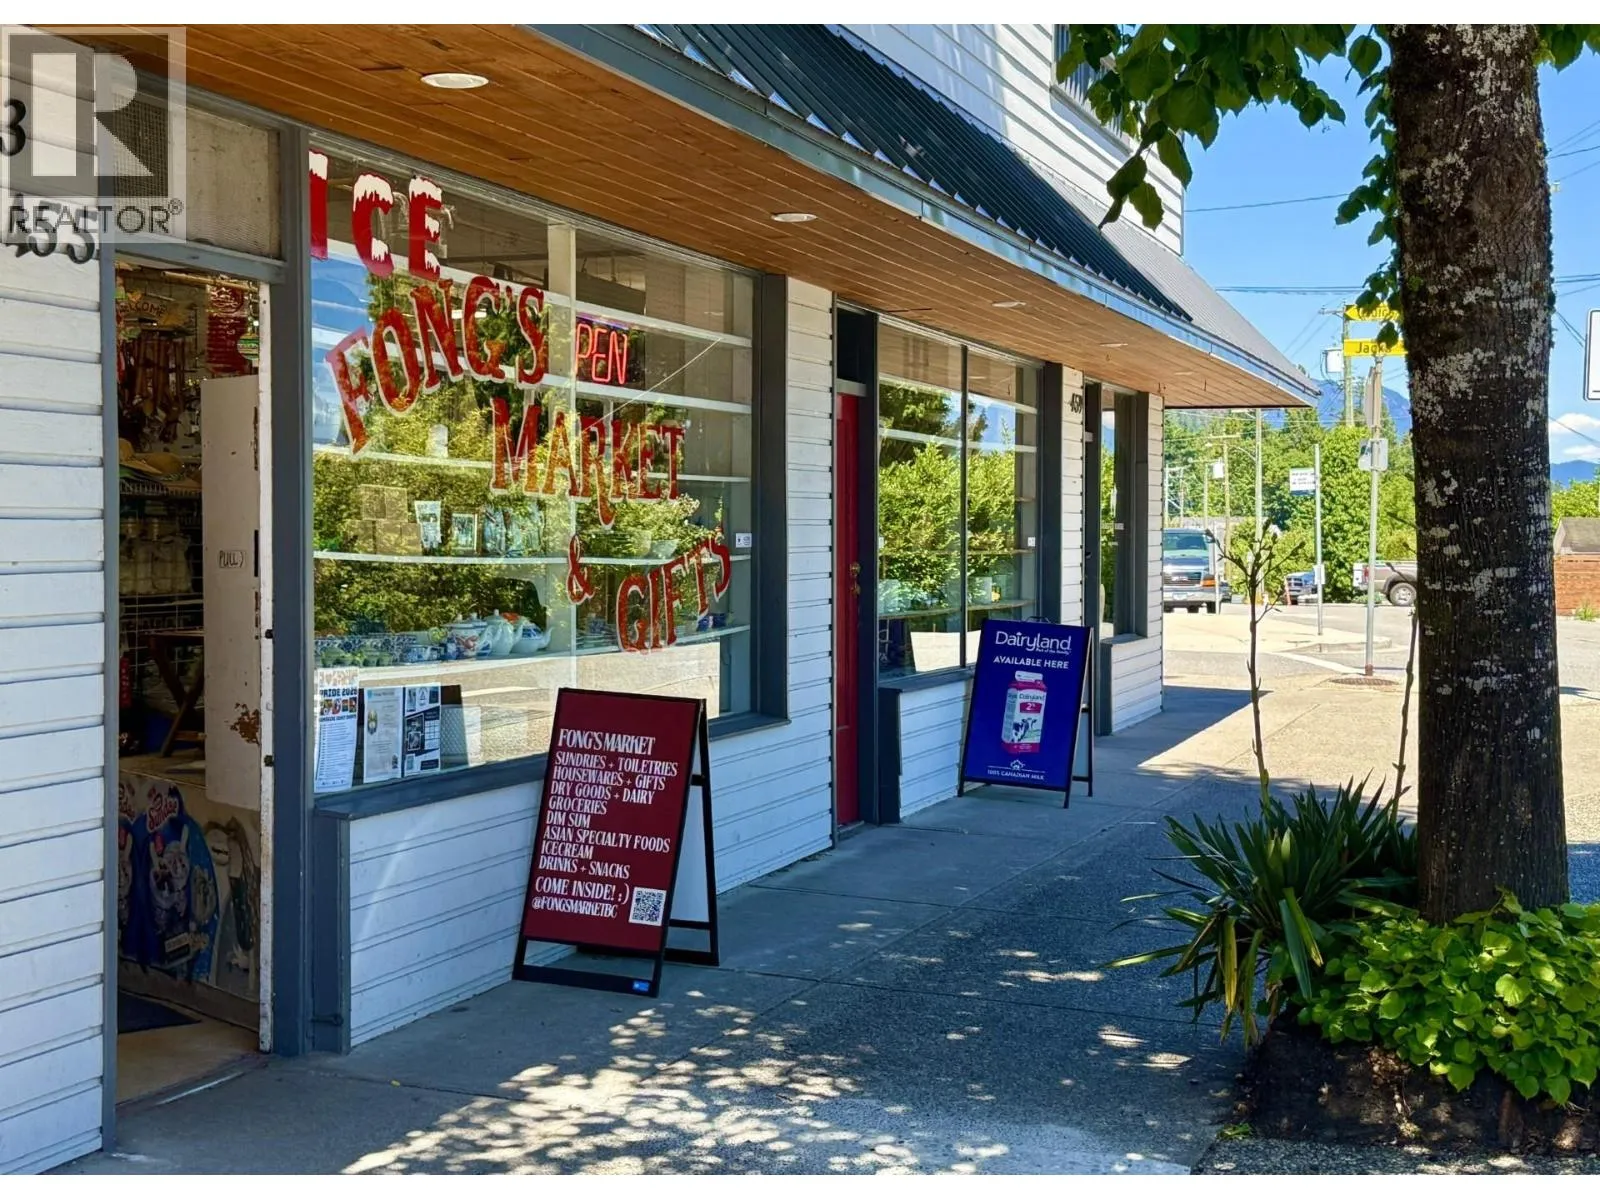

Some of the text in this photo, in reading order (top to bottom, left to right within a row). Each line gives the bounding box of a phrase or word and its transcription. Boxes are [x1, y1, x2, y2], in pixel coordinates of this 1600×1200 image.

[308, 149, 443, 281] ICE
[325, 275, 549, 456] FONG'S
[575, 323, 628, 385] PEN
[490, 395, 685, 530] MARKET
[564, 533, 732, 655] & GIFTS
[995, 630, 1072, 651] Dairyland
[993, 655, 1069, 669] AVAILABLE HERE
[558, 728, 656, 756] FONG'S MARKET
[554, 751, 607, 770] SUNDRIES
[618, 756, 678, 776] TOILETRIES
[552, 765, 624, 787] HOUSEWARES
[635, 774, 666, 791] GIFTS
[548, 795, 608, 815] GROCERIES
[550, 780, 573, 796] DRY
[575, 782, 612, 801] GOODS
[622, 788, 655, 805] DAIRY
[546, 810, 591, 829] DIM SUM
[540, 840, 594, 860] ICECREAM
[543, 825, 671, 853] ASIAN SPECIALTY FOODS
[538, 855, 579, 874] DRINKS
[588, 861, 630, 879] SNACKS
[535, 876, 570, 896] COME
[571, 880, 617, 901] INSIDE!
[531, 895, 619, 918] @FONGSMARKETBC
